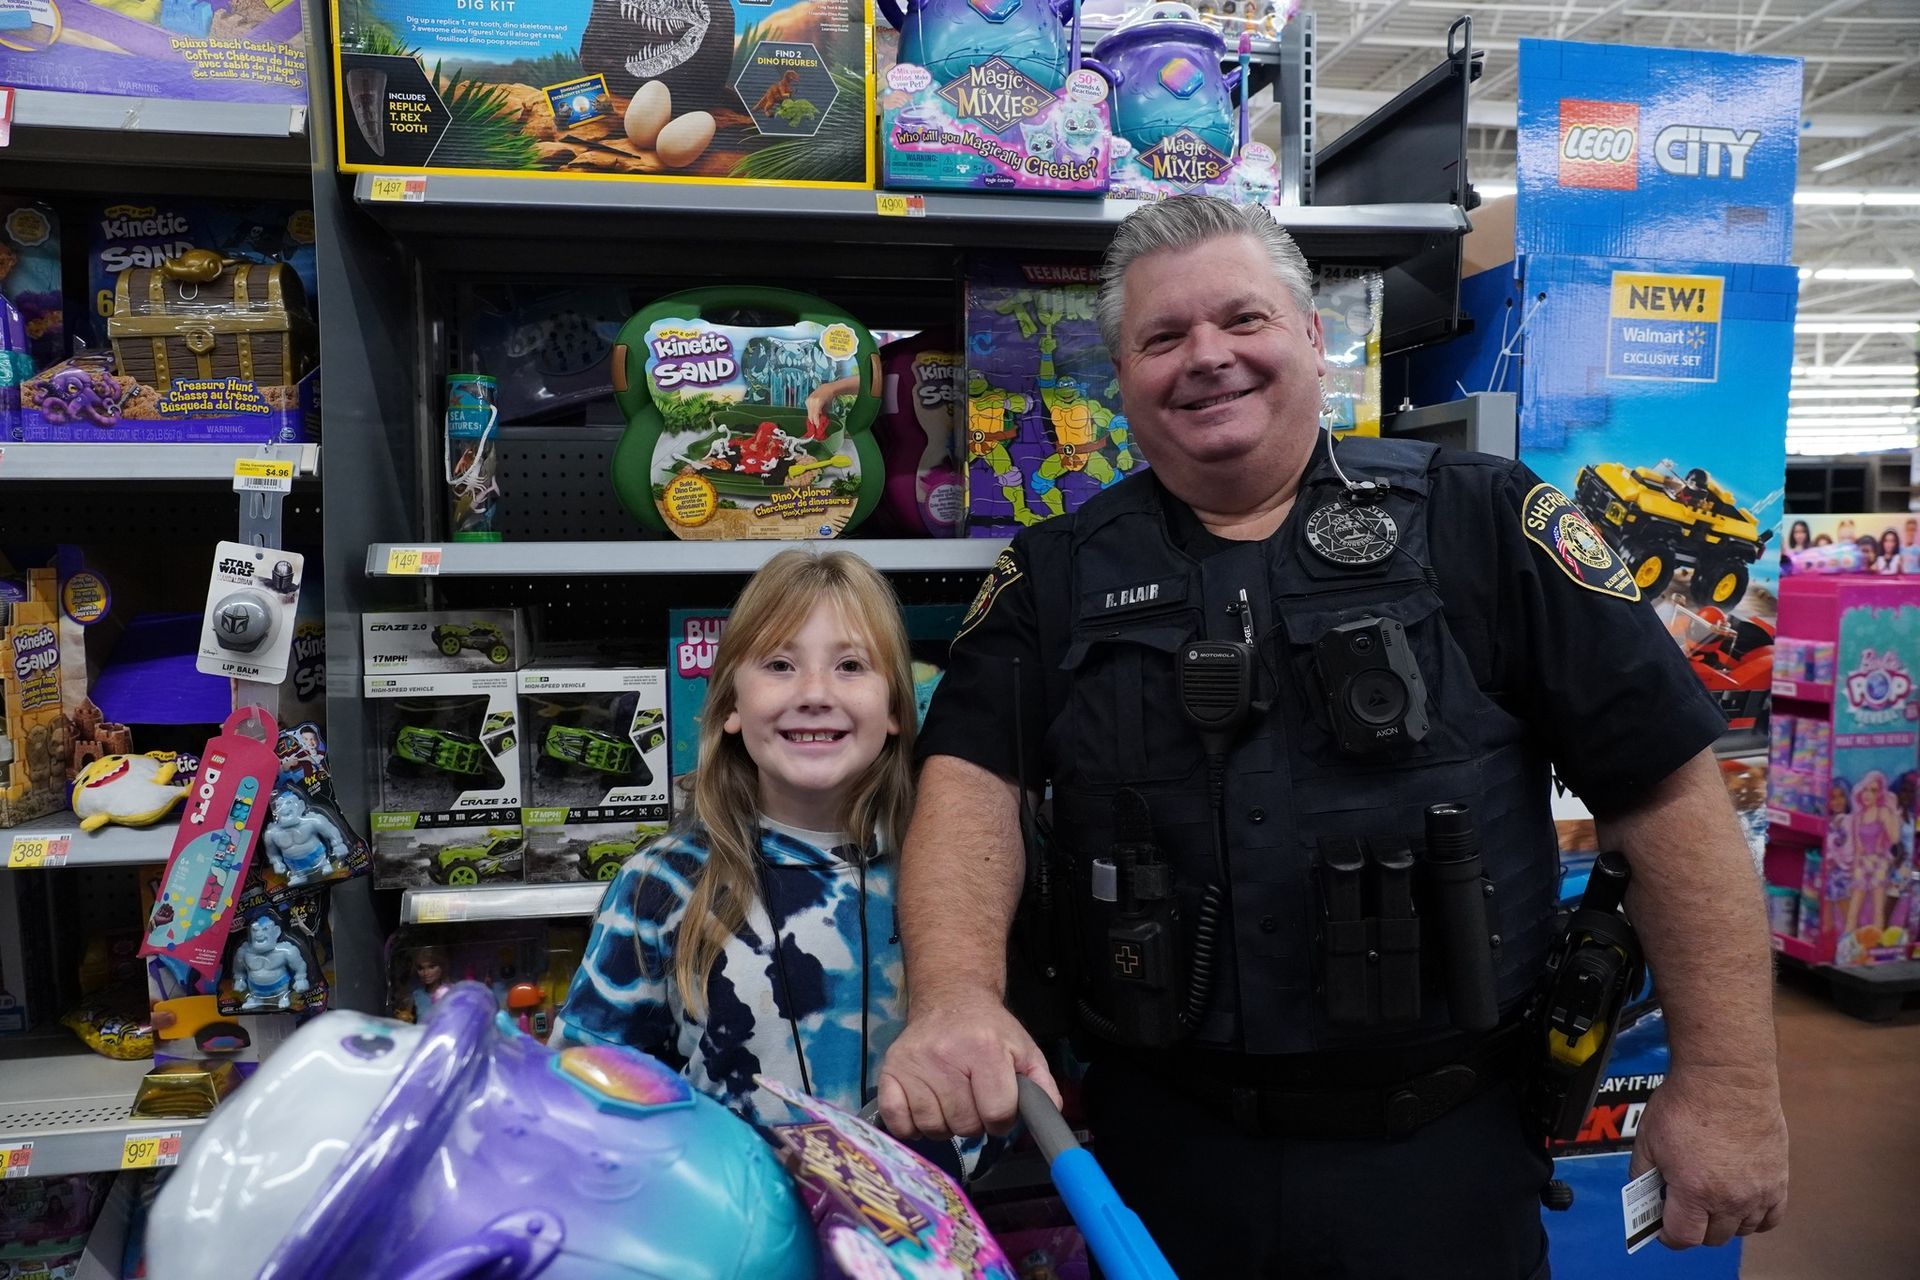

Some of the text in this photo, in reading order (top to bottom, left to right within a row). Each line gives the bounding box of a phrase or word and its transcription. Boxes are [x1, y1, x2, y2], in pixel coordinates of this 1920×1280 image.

[457, 0, 516, 12] DIG KIT
[406, 15, 419, 25] Dig
[420, 18, 430, 26] up
[436, 18, 460, 27] replica
[480, 20, 502, 28] tooth,
[519, 23, 553, 31] skeletons,
[467, 27, 494, 37] figures!
[530, 32, 542, 40] get
[171, 38, 208, 49] Deluxe
[208, 39, 241, 50] Beach
[243, 41, 276, 54] Castle
[436, 34, 540, 47] fossilized dino poop specimen!
[185, 49, 224, 61] Coffret
[270, 55, 282, 65] de
[285, 57, 305, 69] luxe
[775, 50, 795, 58] FIND
[199, 61, 295, 75] avec sable de plage
[758, 57, 817, 67] DINO FIGURES!
[210, 70, 238, 78] Castillo
[970, 66, 1023, 95] Magic
[1078, 73, 1098, 85] 50+
[1073, 82, 1095, 91] Sounds
[389, 92, 426, 101] INCLUDES
[389, 102, 432, 112] REPLICA
[958, 88, 1039, 121] MIXIES
[390, 112, 421, 122] T. REX
[390, 123, 428, 133] TOOTH
[1163, 137, 1207, 158] Magic
[1563, 124, 1762, 180] LEGO CITY
[897, 130, 1098, 181] Who will you Magically Create?
[1152, 154, 1221, 183] MIXIES
[101, 211, 189, 240] Kinetic
[1022, 265, 1087, 281] TEENAGE
[96, 289, 114, 318] 6
[1628, 284, 1706, 314] NEW!
[1623, 326, 1685, 345] Walmart
[654, 334, 728, 359] Kinetic
[1623, 352, 1703, 367] EXCLUSIVE SET
[655, 358, 735, 386] SAND
[176, 379, 254, 393] Treasure Hunt
[170, 390, 260, 403] Chasse au trésor
[160, 400, 269, 414] Búsqueda del tesoro
[450, 411, 466, 421] SEA
[206, 425, 246, 434] WARNING:
[266, 468, 289, 477] $4.96
[771, 486, 831, 503] DinoXplorer
[755, 497, 850, 516] Chercheur de dinosaures
[219, 558, 255, 570] STAR
[219, 565, 255, 577] WARS
[1106, 584, 1159, 609] R. BLAIR
[412, 623, 428, 631] 2.0
[15, 629, 54, 652] Kinetic
[16, 649, 58, 676] SAND
[373, 655, 408, 663] 17MPH!
[222, 663, 259, 675] LIP BALM
[1376, 727, 1399, 738] AXON
[190, 767, 221, 826] DOTS
[460, 797, 518, 807] CRAZE 2.0
[609, 793, 665, 803] CRAZE 2.0
[378, 815, 412, 824] 17MPH!
[528, 810, 562, 819] 17MPH!
